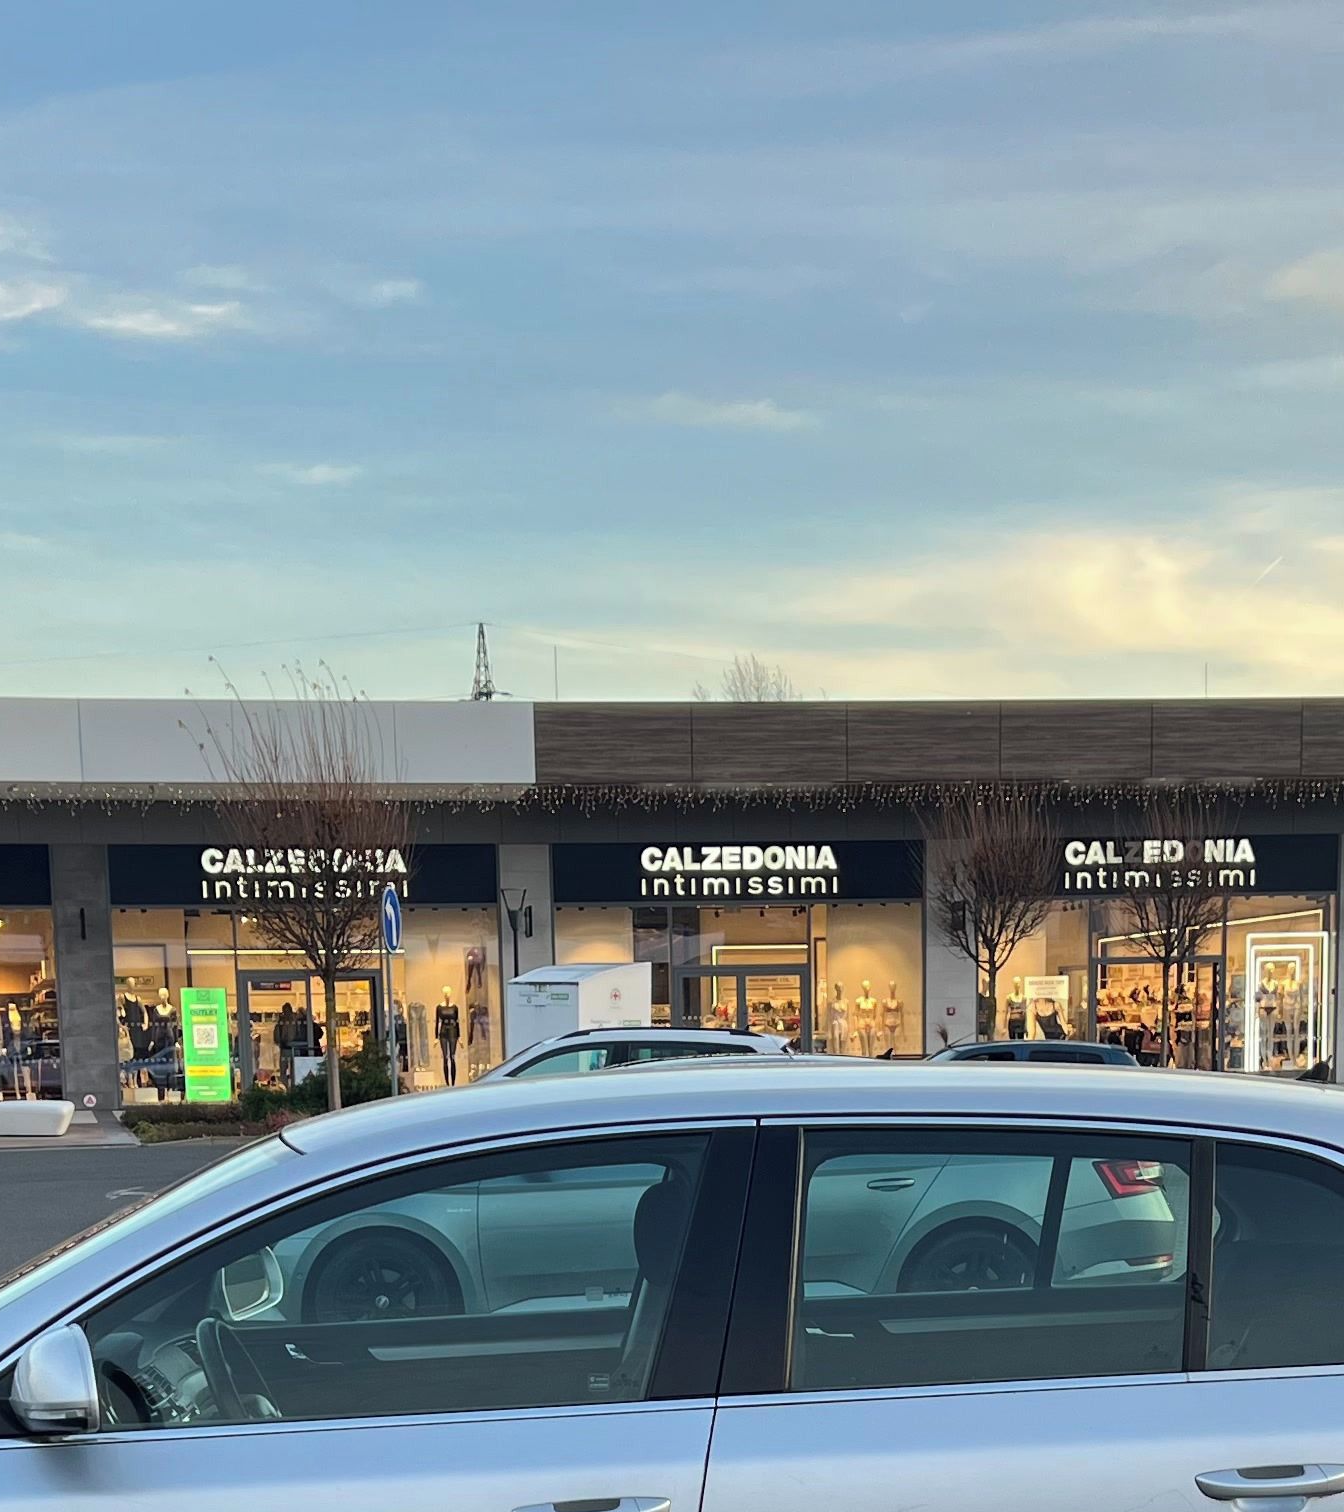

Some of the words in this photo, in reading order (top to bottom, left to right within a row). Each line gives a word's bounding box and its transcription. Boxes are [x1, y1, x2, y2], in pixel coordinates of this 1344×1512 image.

[640, 845, 838, 871] CALZEDONIA
[1064, 839, 1256, 866] CALZEDONIA
[641, 874, 838, 896] intimissimi
[1064, 867, 1256, 889] intimissimi
